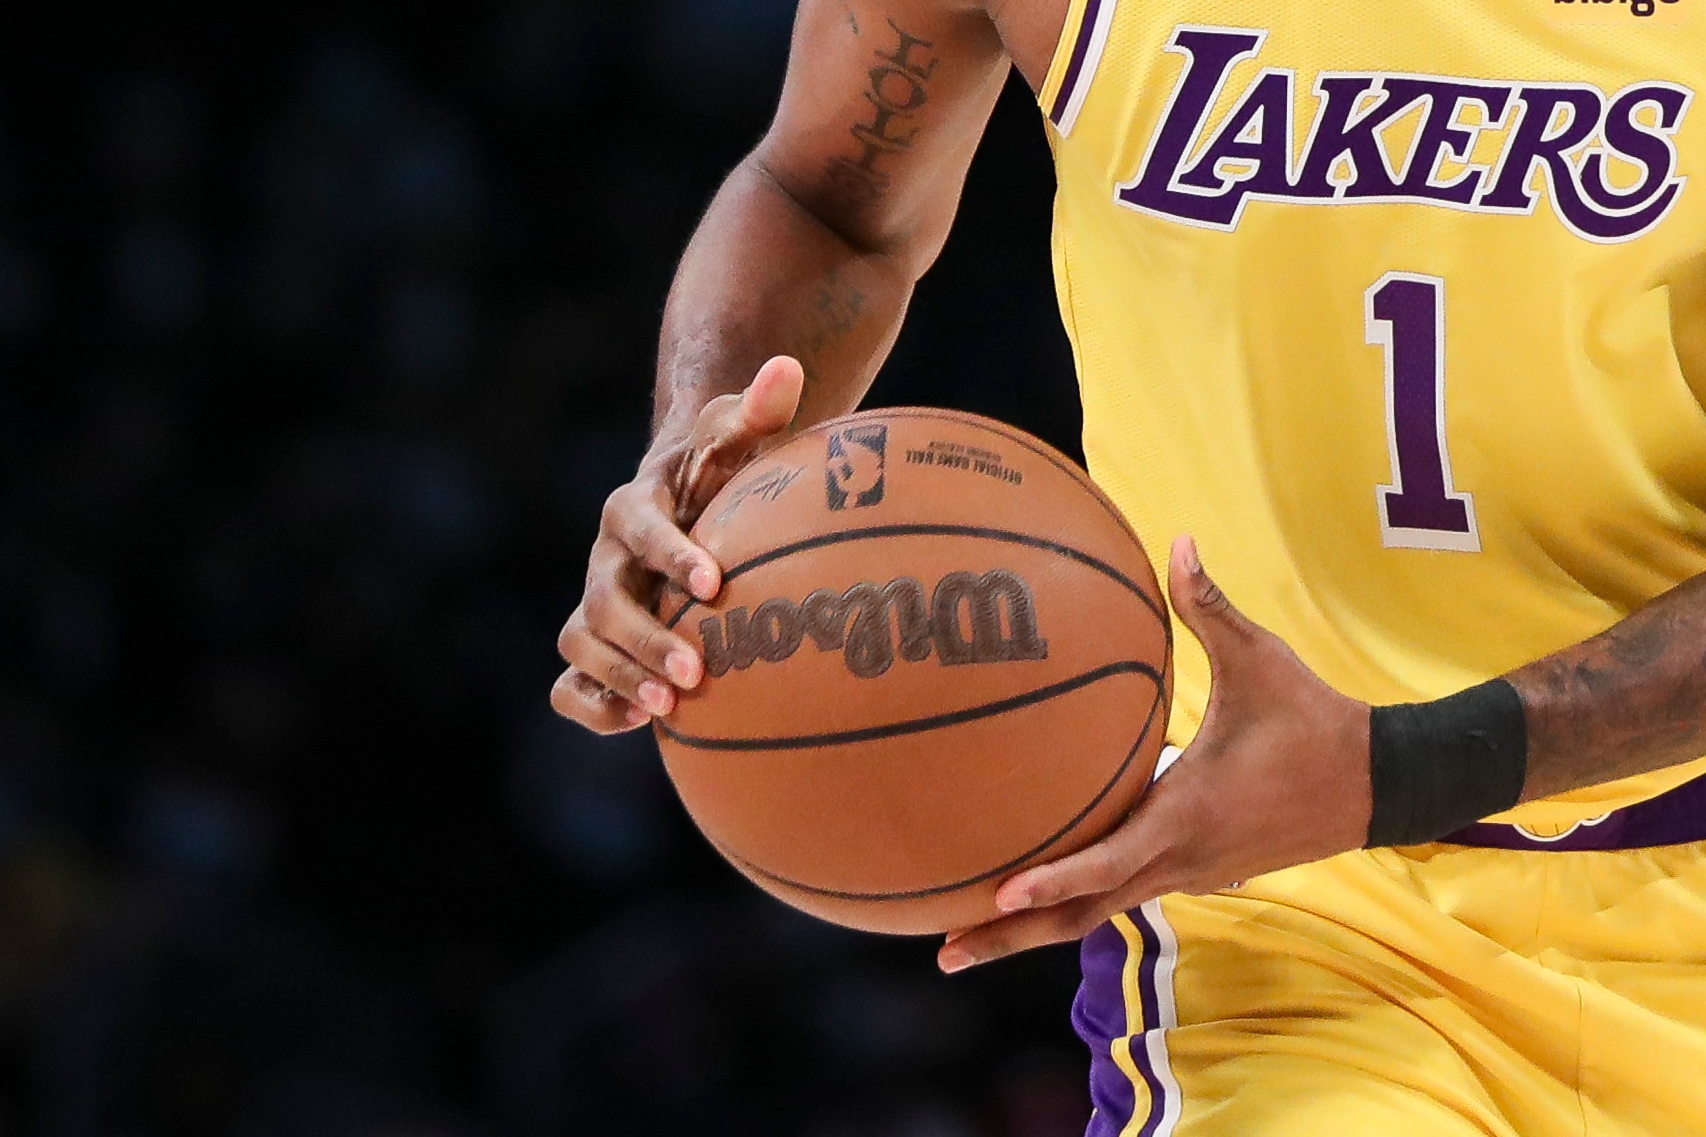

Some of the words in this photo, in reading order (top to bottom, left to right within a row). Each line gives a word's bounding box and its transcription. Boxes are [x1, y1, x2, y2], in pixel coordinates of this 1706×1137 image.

[1114, 24, 1694, 244] LAKERS
[1364, 270, 1482, 553] 1
[699, 568, 1049, 679] Wilson
